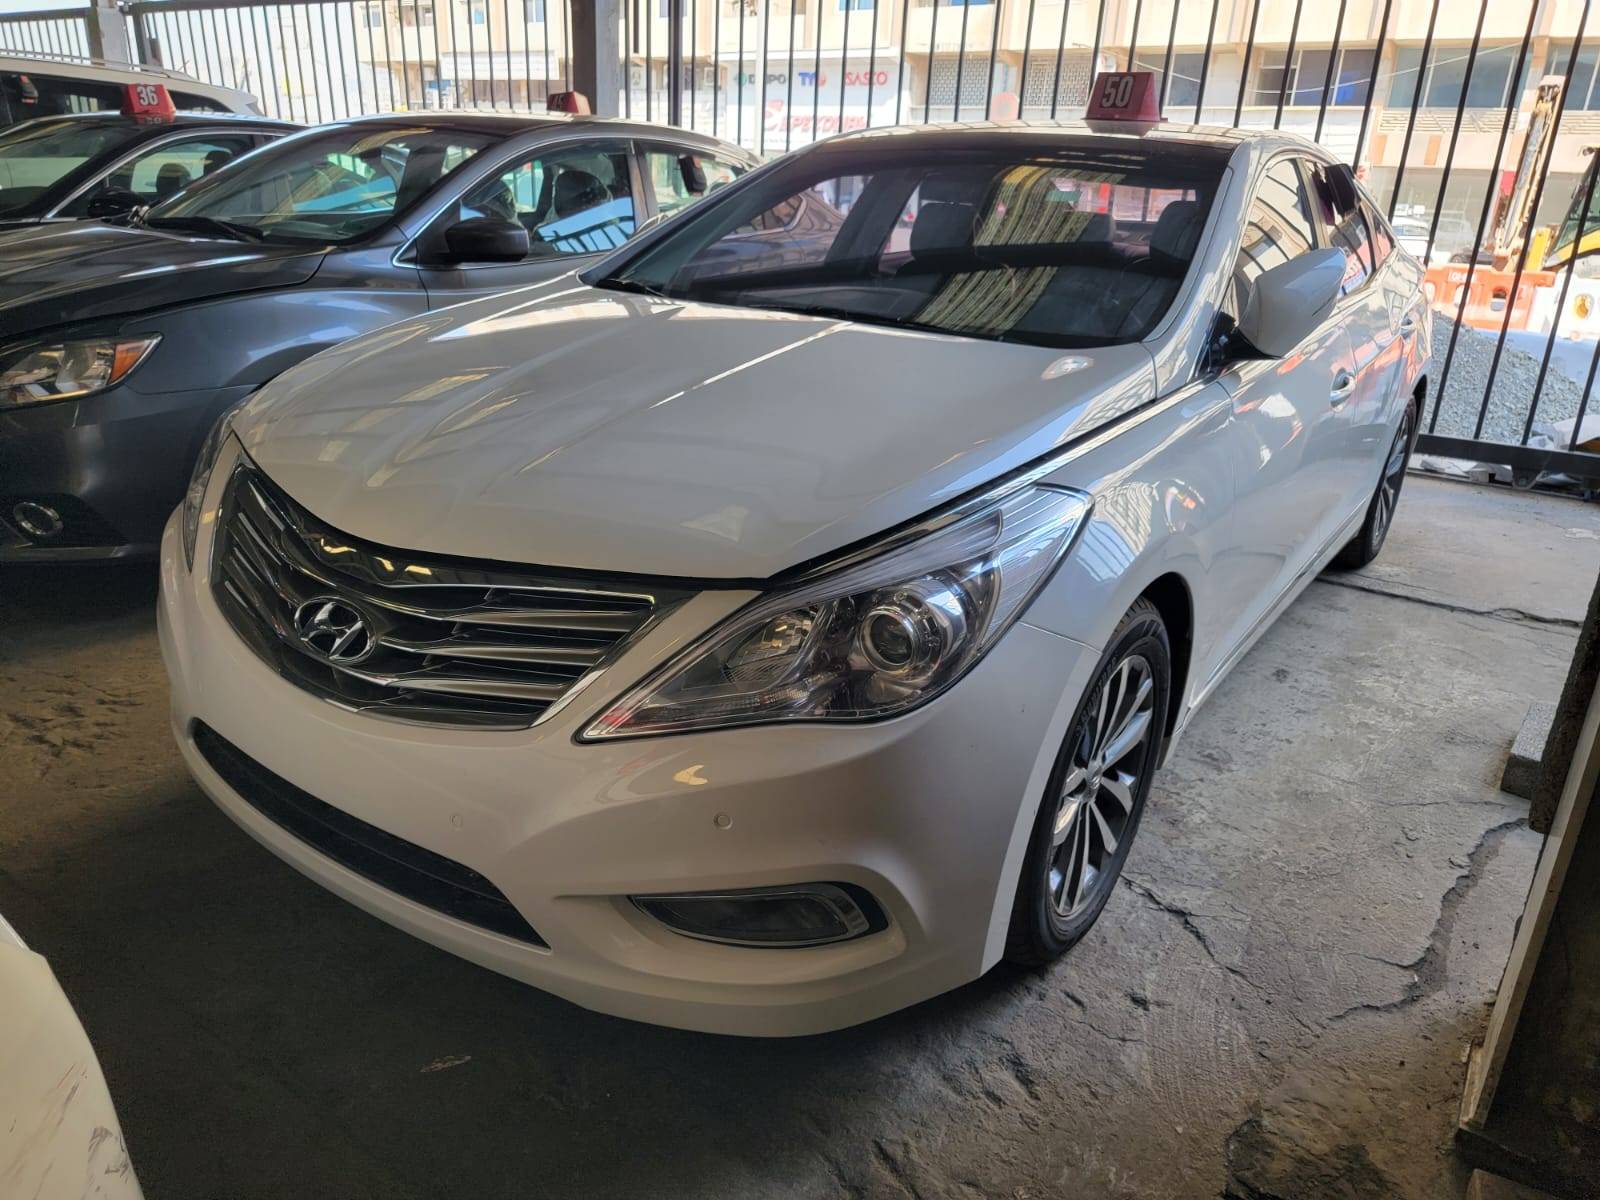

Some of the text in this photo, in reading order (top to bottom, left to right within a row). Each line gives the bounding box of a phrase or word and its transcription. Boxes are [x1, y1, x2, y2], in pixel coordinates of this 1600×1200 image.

[748, 73, 787, 86] DPO
[136, 86, 158, 105] 36
[1101, 75, 1134, 107] 50
